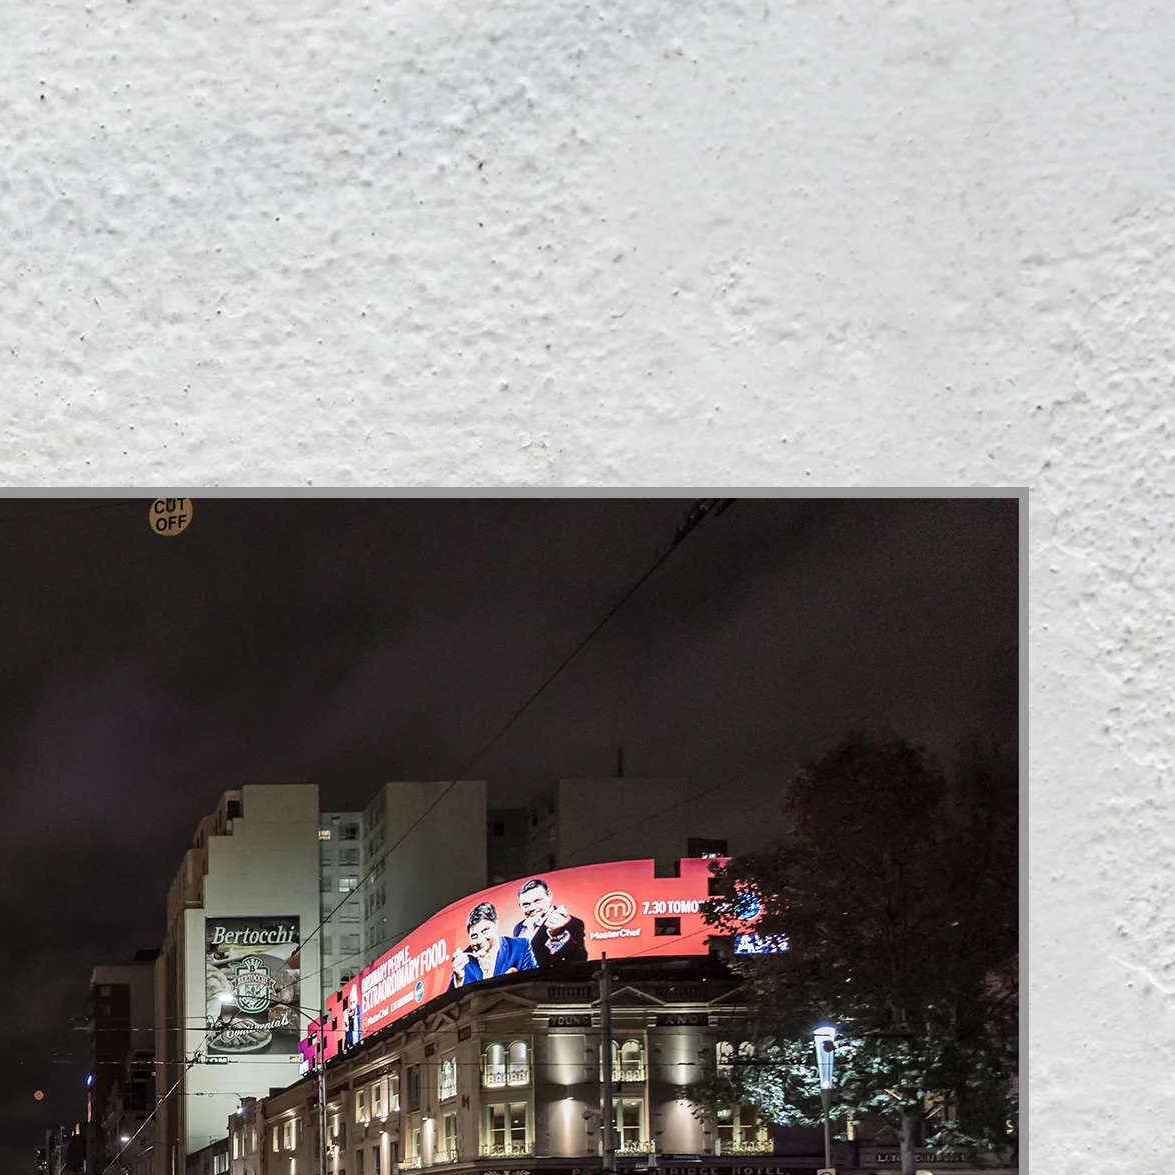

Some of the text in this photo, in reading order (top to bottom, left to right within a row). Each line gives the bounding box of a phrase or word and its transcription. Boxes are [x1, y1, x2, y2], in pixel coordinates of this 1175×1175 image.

[154, 498, 186, 514] CUT
[156, 514, 187, 531] OFF
[642, 901, 704, 915] 7.30 TOMO
[212, 926, 295, 945] Bertocchi
[589, 928, 641, 940] MasterChef
[362, 955, 420, 1014] EXTRAORDINARY
[420, 939, 450, 976] FOOD.
[549, 1015, 589, 1026] YOUNG
[664, 1015, 700, 1025] AND
